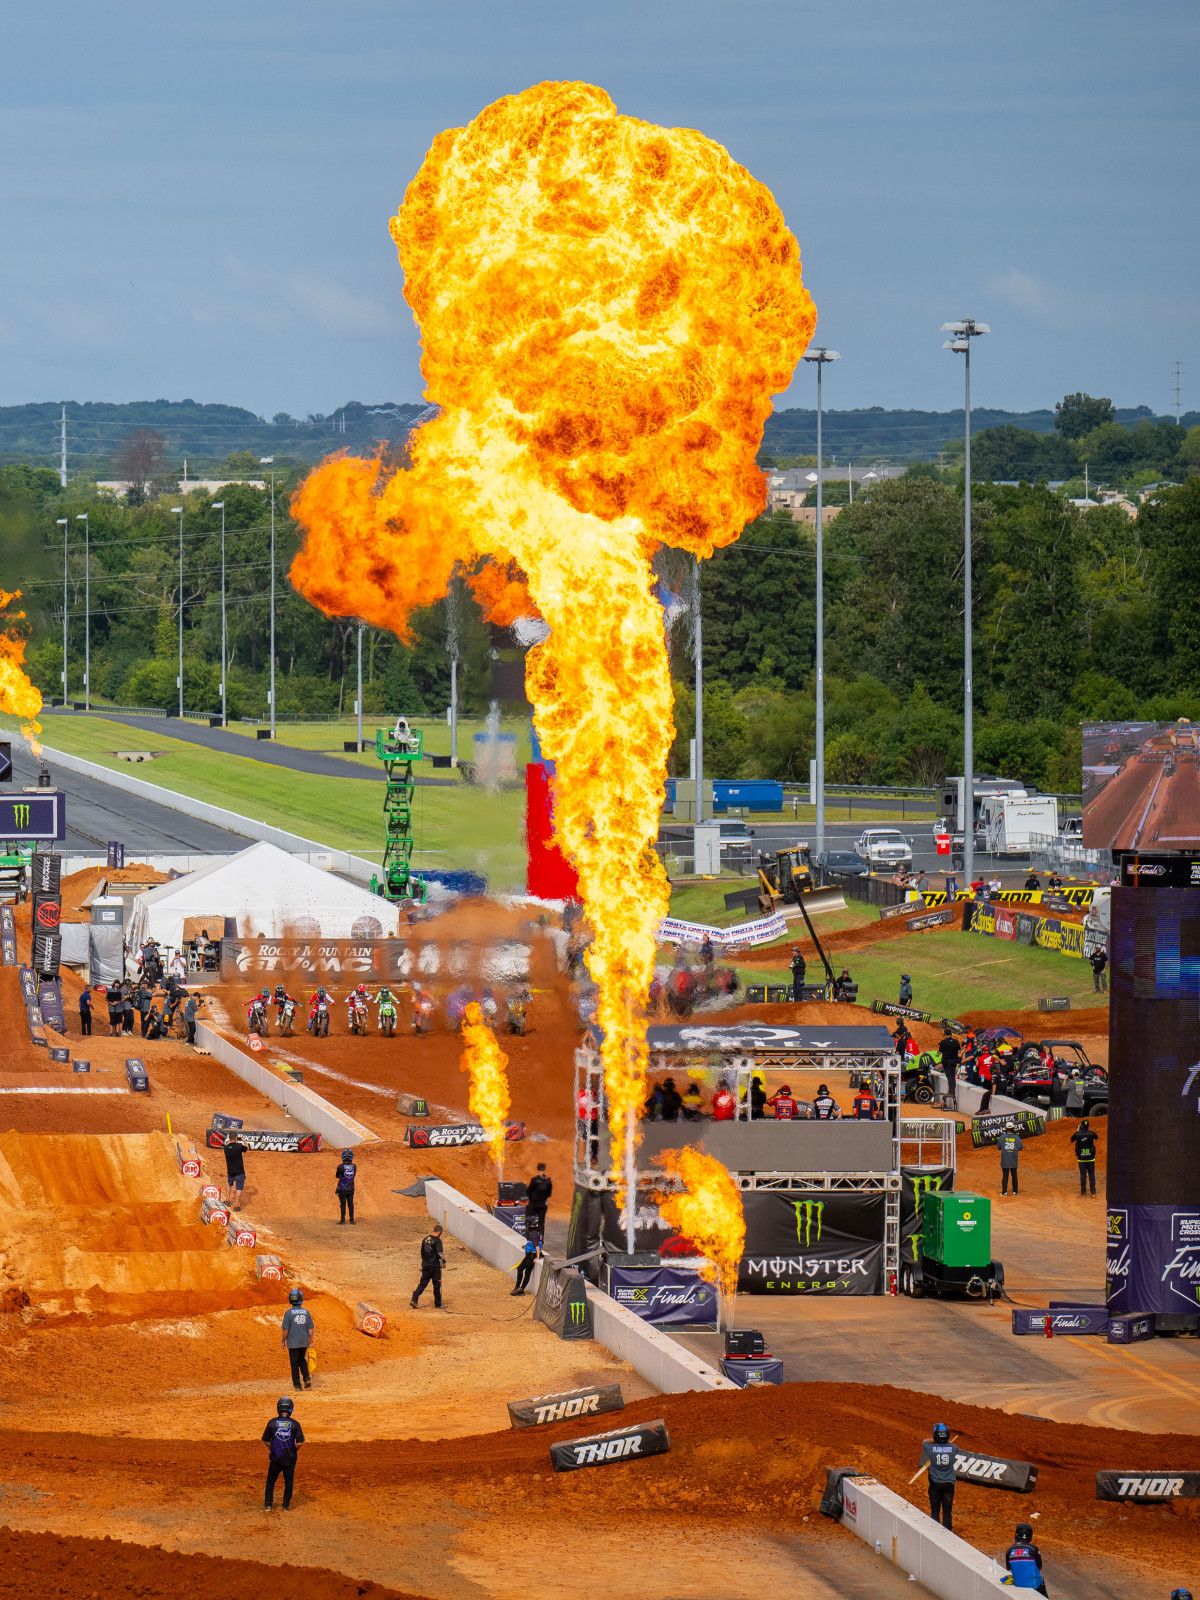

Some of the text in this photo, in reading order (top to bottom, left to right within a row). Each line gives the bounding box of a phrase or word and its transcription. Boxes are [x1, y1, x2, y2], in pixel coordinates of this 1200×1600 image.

[885, 1004, 921, 1018] MONSTER
[982, 1115, 1015, 1126] MONSTER
[261, 1135, 299, 1143] MOUNTAIN
[747, 1256, 869, 1278] MONSTER
[1107, 1244, 1131, 1276] nals
[1161, 1245, 1200, 1282] Fin
[766, 1281, 851, 1289] ENERGY
[650, 1285, 695, 1306] Finals
[1052, 1315, 1080, 1327] Finals
[534, 1394, 600, 1425] THOR
[574, 1435, 643, 1465] THOR
[936, 1454, 950, 1465] 19
[1117, 1477, 1185, 1496] THOR
